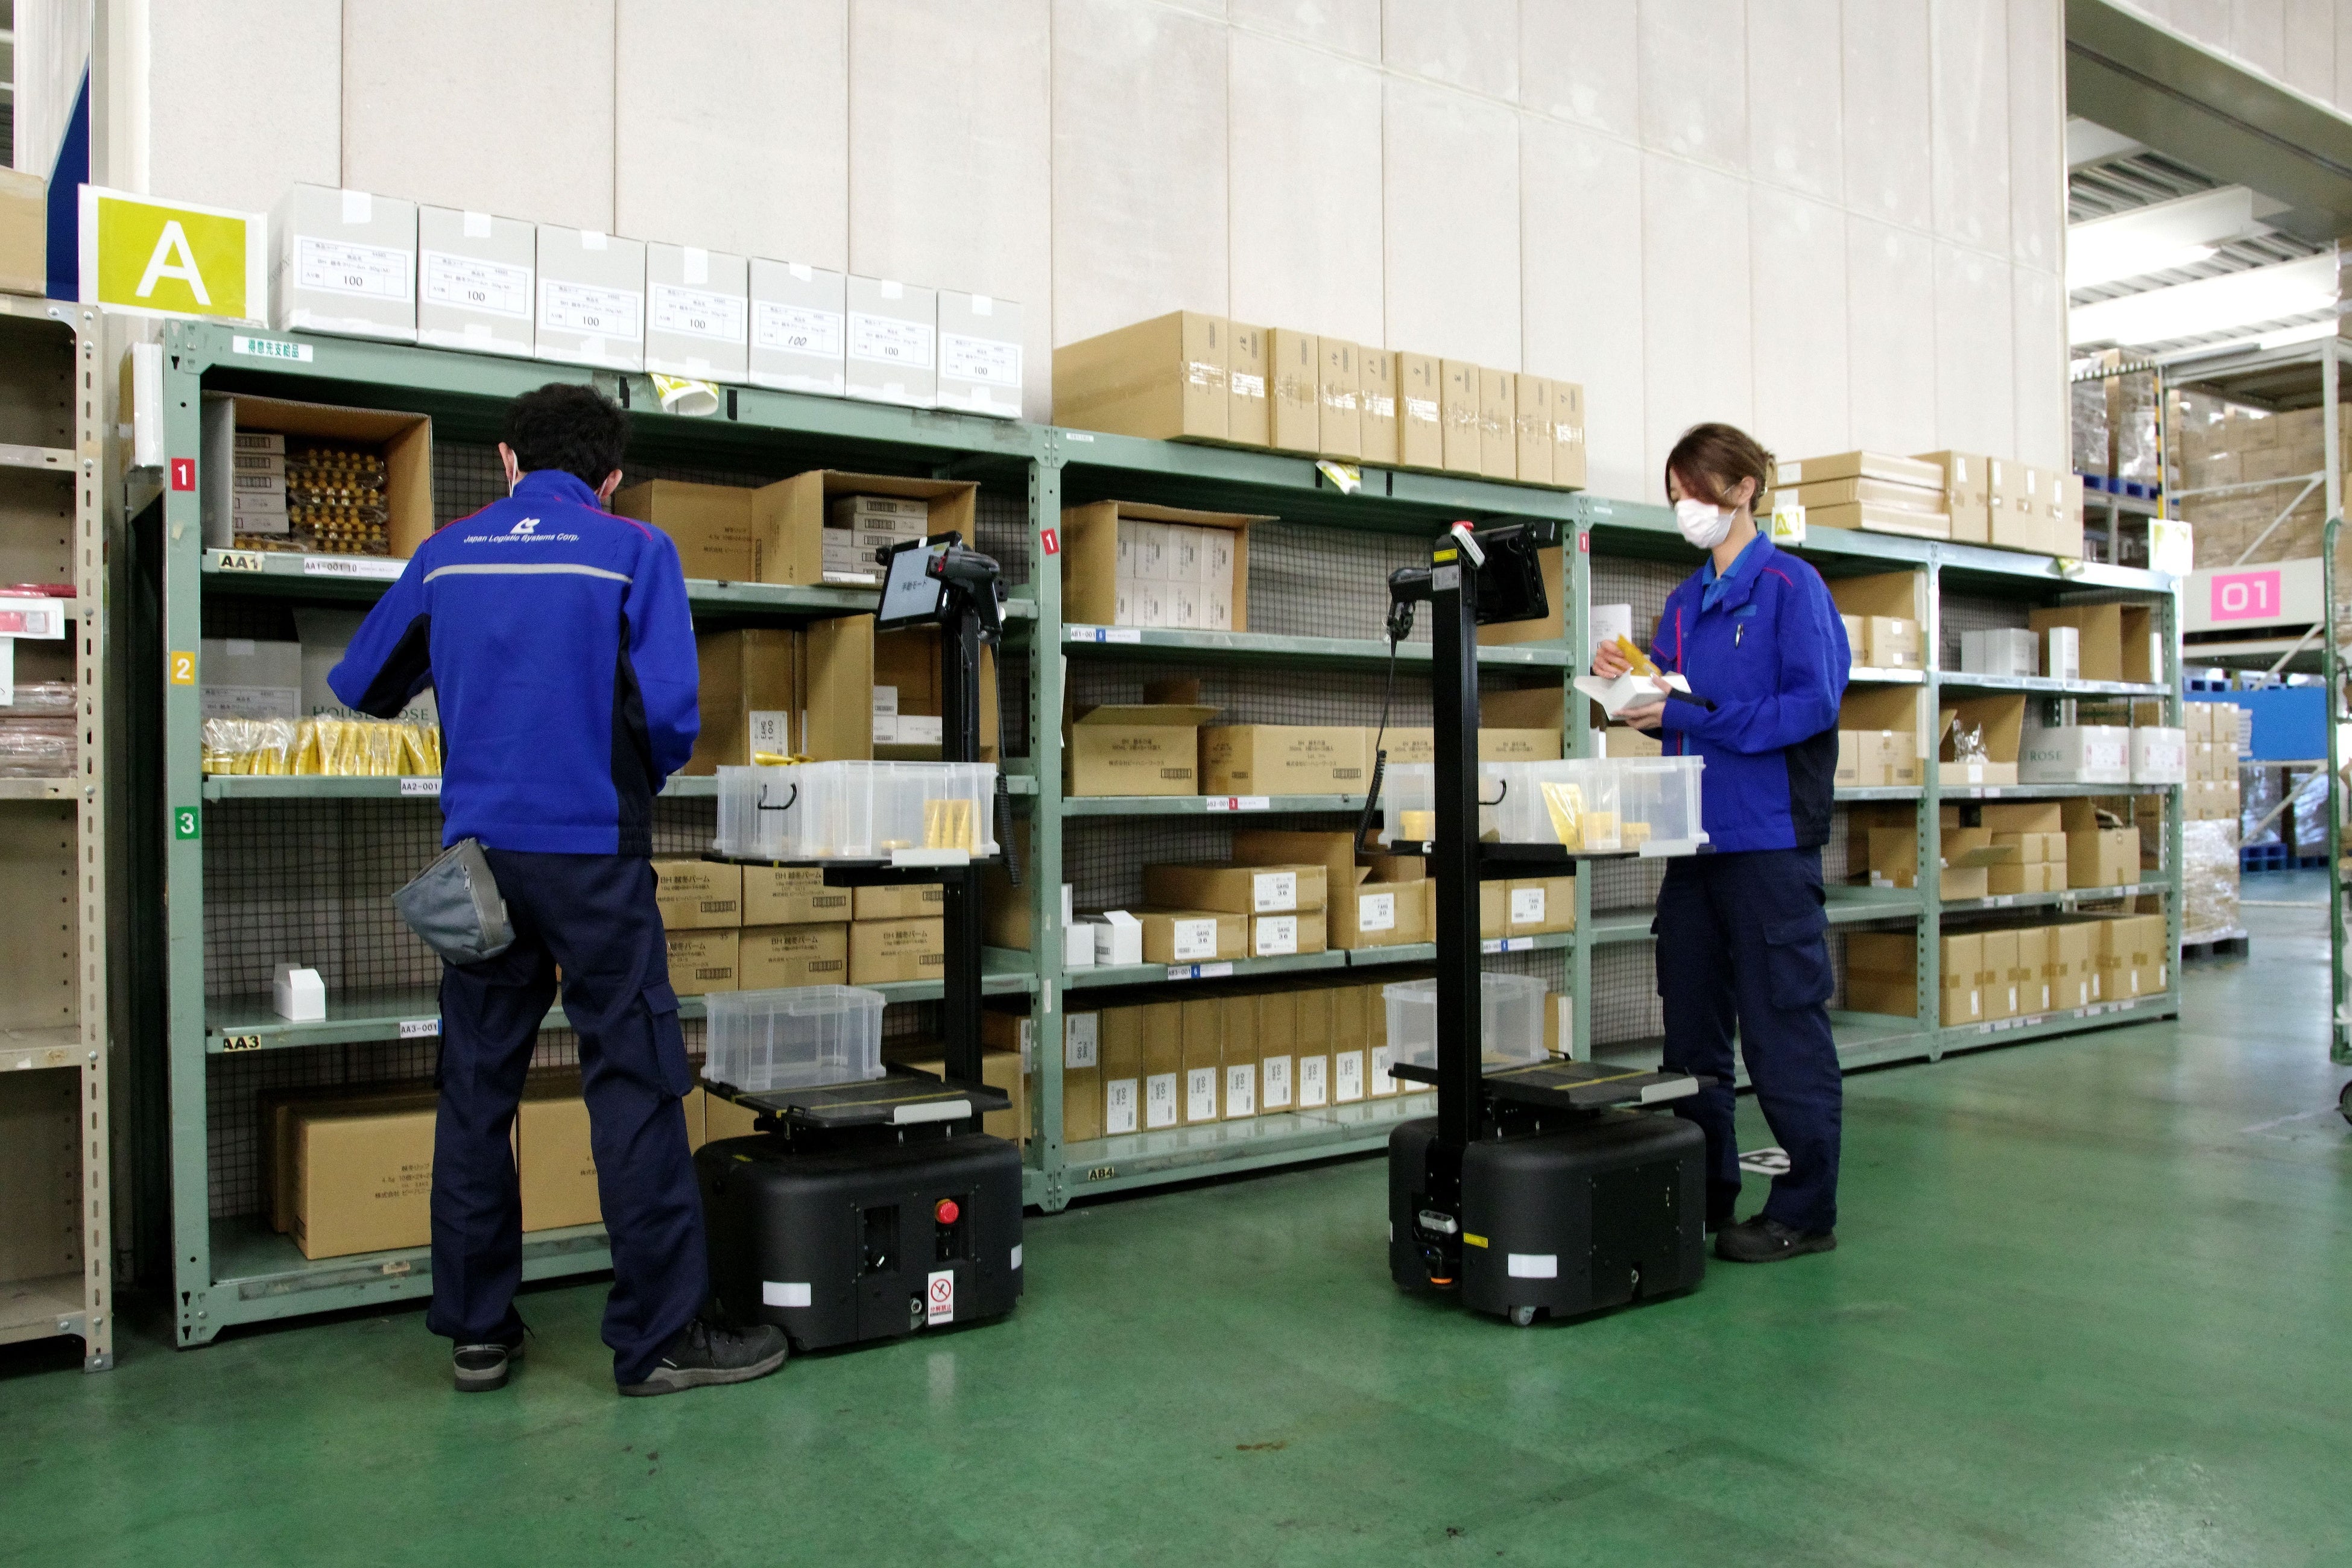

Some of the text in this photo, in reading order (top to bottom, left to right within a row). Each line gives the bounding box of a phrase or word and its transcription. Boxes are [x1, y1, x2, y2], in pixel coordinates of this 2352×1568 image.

[135, 220, 212, 306] A
[344, 275, 363, 287] 100
[467, 290, 485, 302] 100
[583, 315, 599, 327] 100
[689, 318, 706, 329] 100
[788, 335, 807, 347] 100
[884, 346, 899, 356] 100
[974, 365, 988, 376] 100
[179, 464, 188, 485] 1
[464, 535, 487, 543] Japan
[521, 534, 555, 543] Systems
[1046, 534, 1054, 551] 1
[1582, 536, 1586, 549] 1
[221, 555, 258, 569] AA1
[2221, 580, 2268, 612] 01
[177, 658, 191, 679] 2
[402, 782, 439, 791] AA2-001
[180, 812, 195, 834] 3
[400, 1023, 438, 1034] AA3-001
[223, 1035, 259, 1050] AA3
